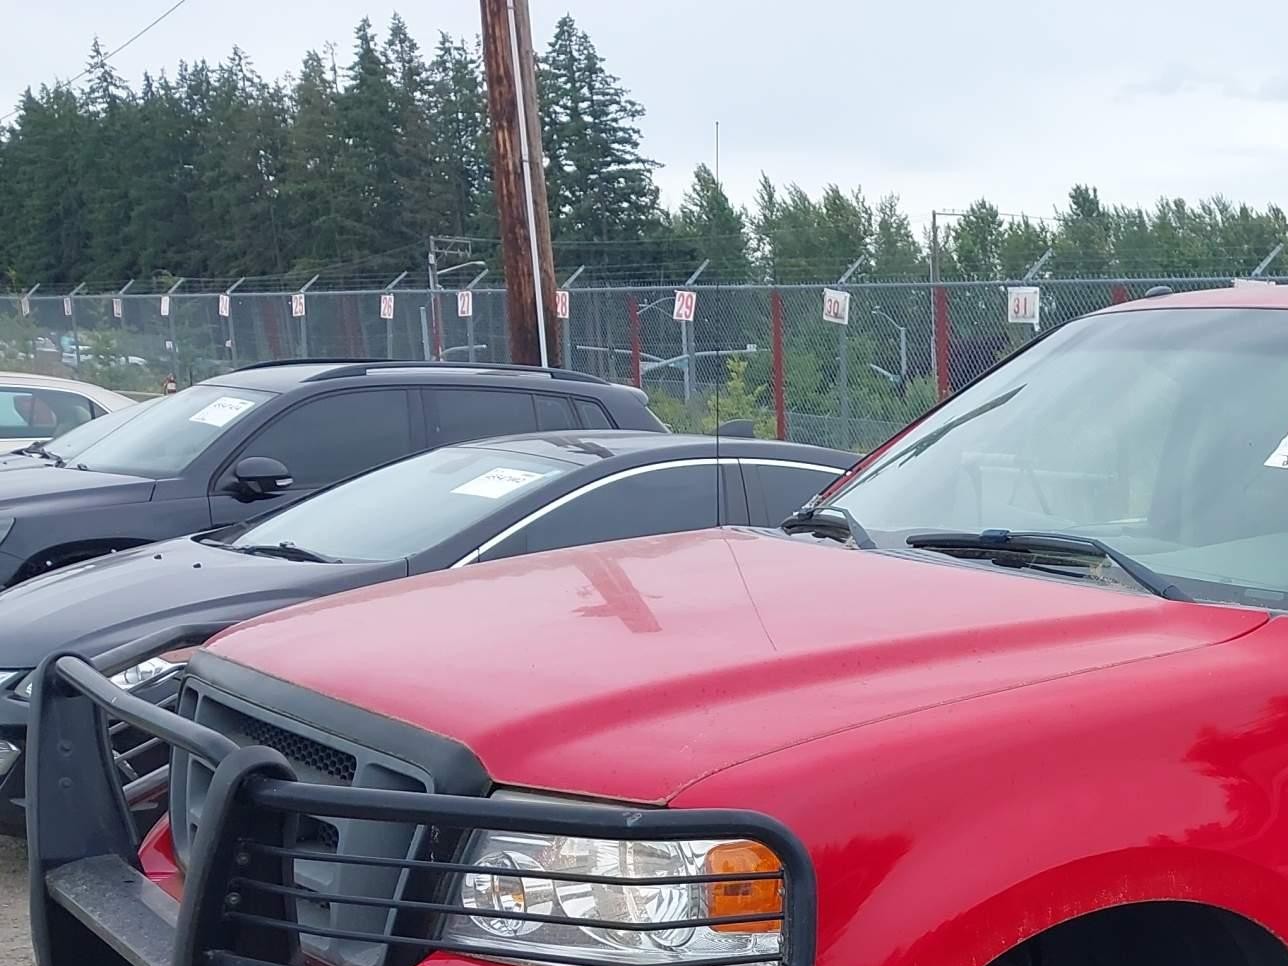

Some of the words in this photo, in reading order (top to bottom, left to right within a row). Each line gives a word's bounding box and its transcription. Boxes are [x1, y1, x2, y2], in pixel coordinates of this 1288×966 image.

[293, 295, 304, 315] 25
[382, 297, 393, 317] 26
[459, 293, 470, 315] 27
[676, 293, 694, 319] 29
[826, 298, 839, 316] 30
[1013, 296, 1028, 315] 31
